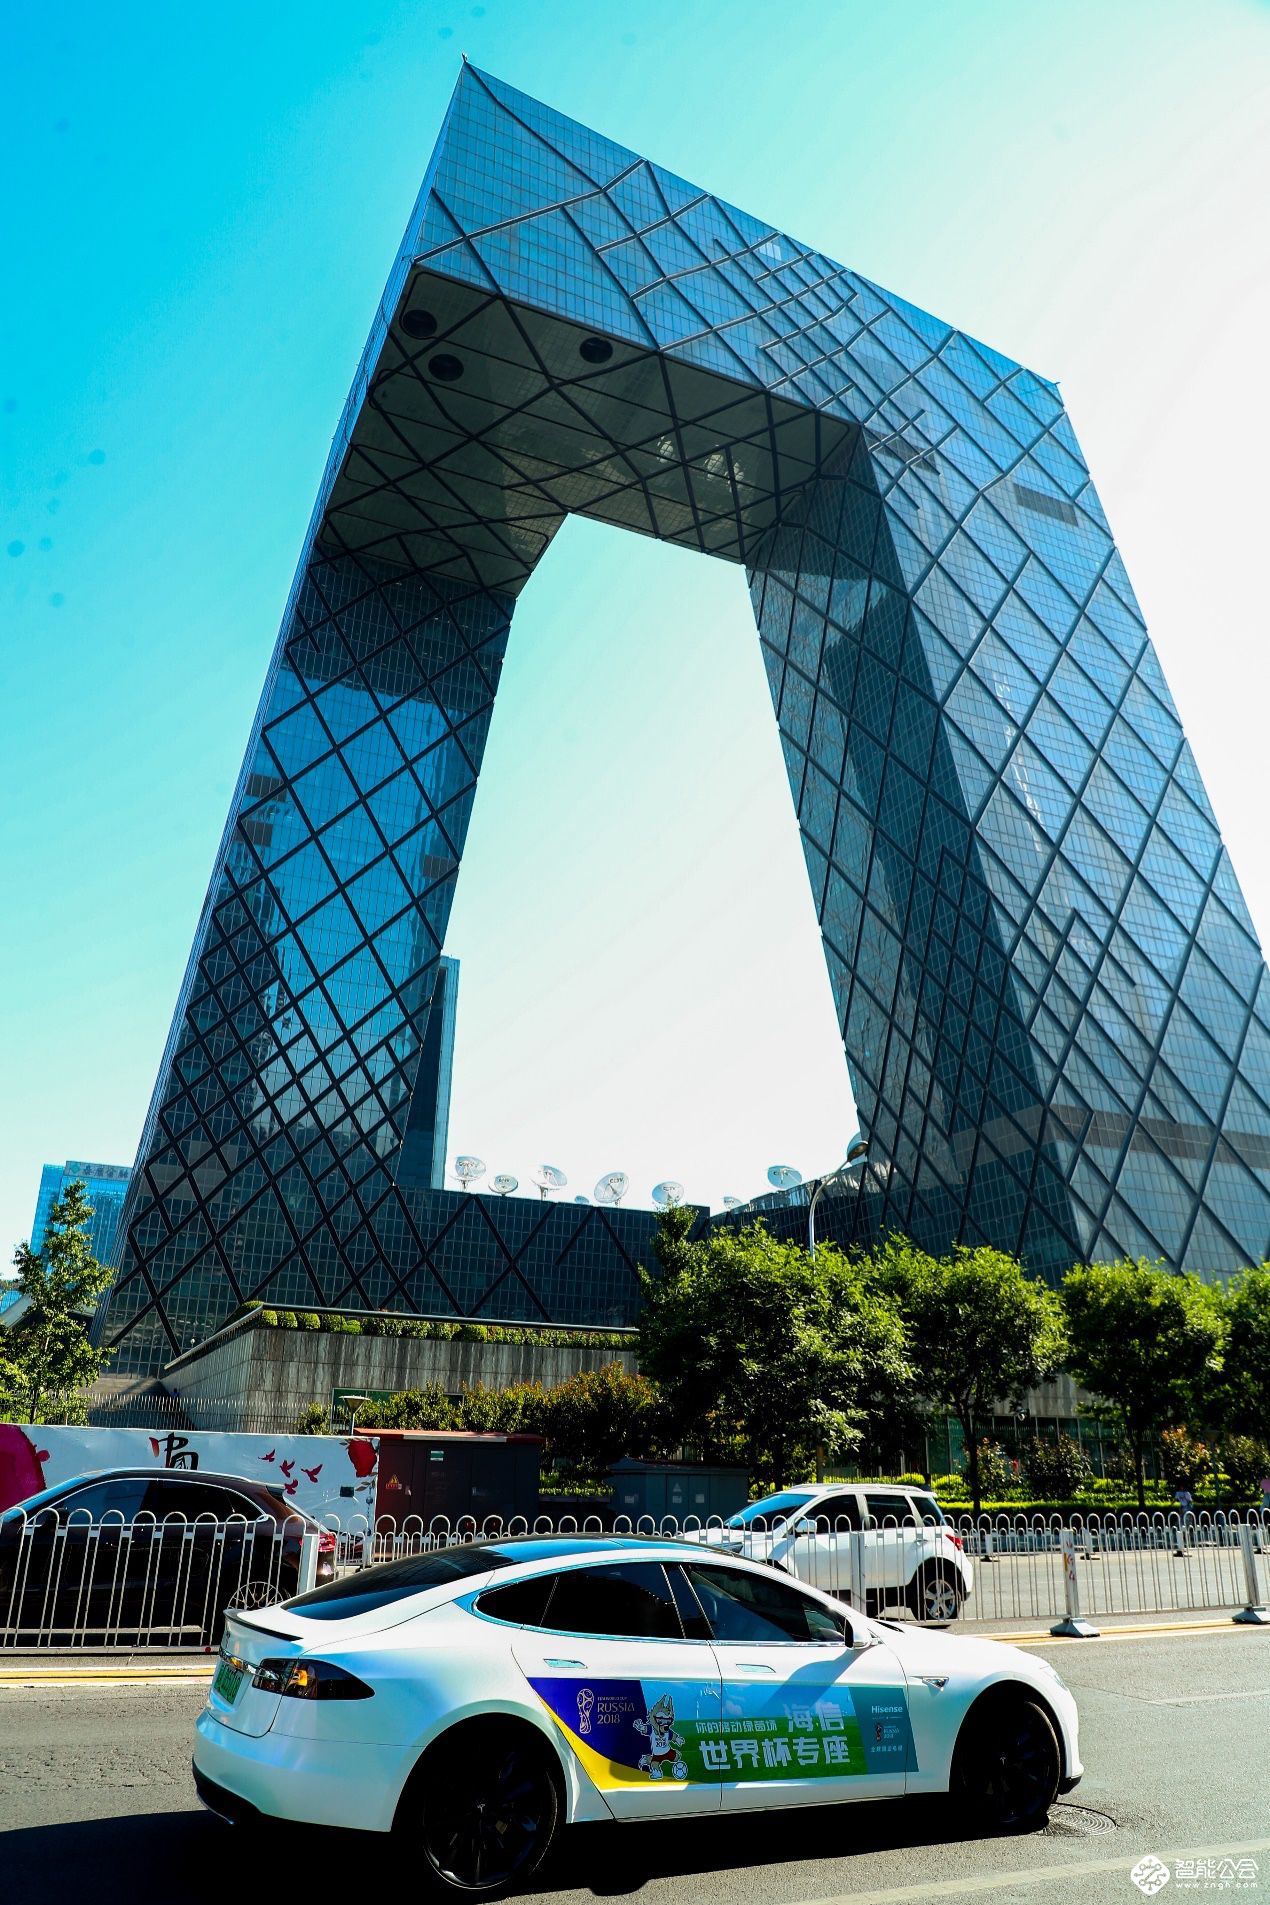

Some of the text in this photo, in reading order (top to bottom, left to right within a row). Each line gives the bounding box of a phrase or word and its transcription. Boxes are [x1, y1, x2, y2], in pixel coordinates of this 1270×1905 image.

[597, 1702, 635, 1713] RUSSIA
[871, 1705, 904, 1714] Hisense
[597, 1714, 621, 1724] 2018
[784, 1701, 845, 1733] 海信
[699, 1735, 850, 1770] 世界杯专座
